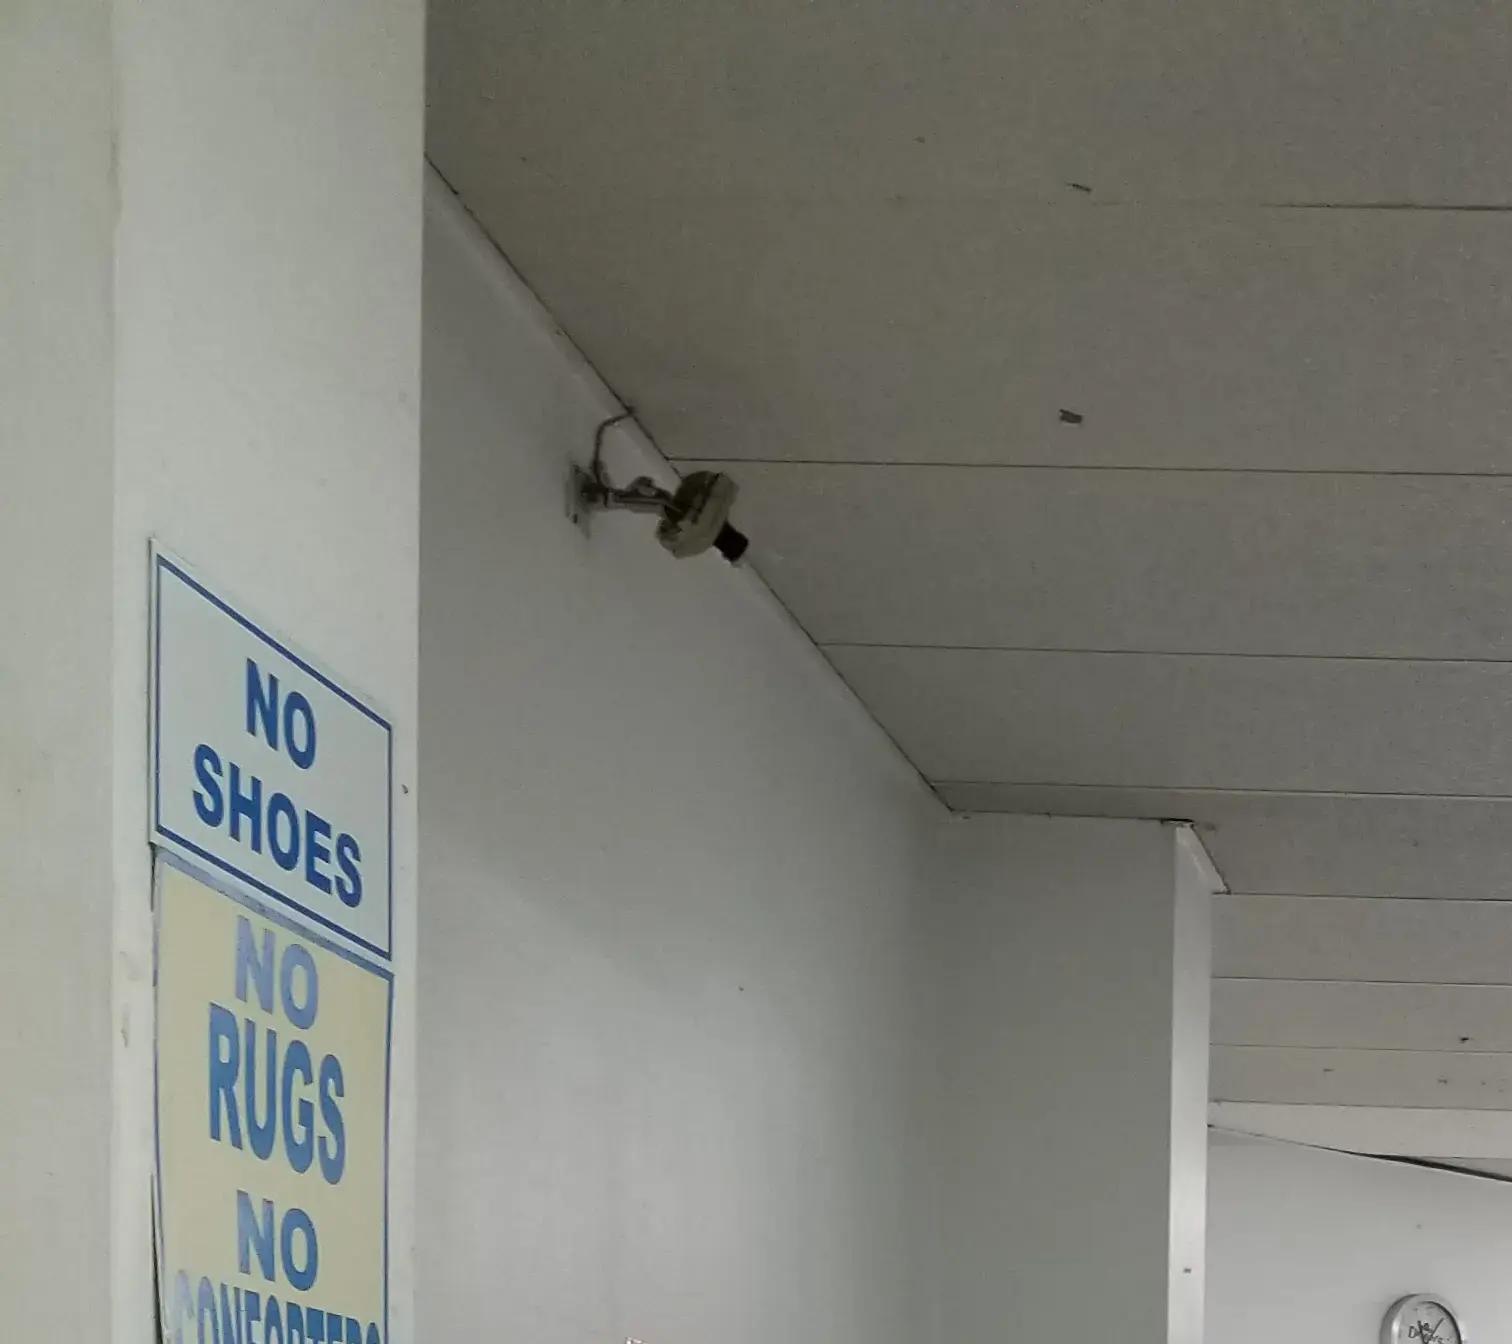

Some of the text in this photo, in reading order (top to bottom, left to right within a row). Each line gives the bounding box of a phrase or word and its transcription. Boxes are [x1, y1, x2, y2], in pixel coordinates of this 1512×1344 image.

[246, 657, 317, 770] NO
[192, 743, 363, 908] SHOES
[235, 914, 319, 1031] NO
[208, 1001, 346, 1186] RUGS
[236, 1190, 319, 1293] NO
